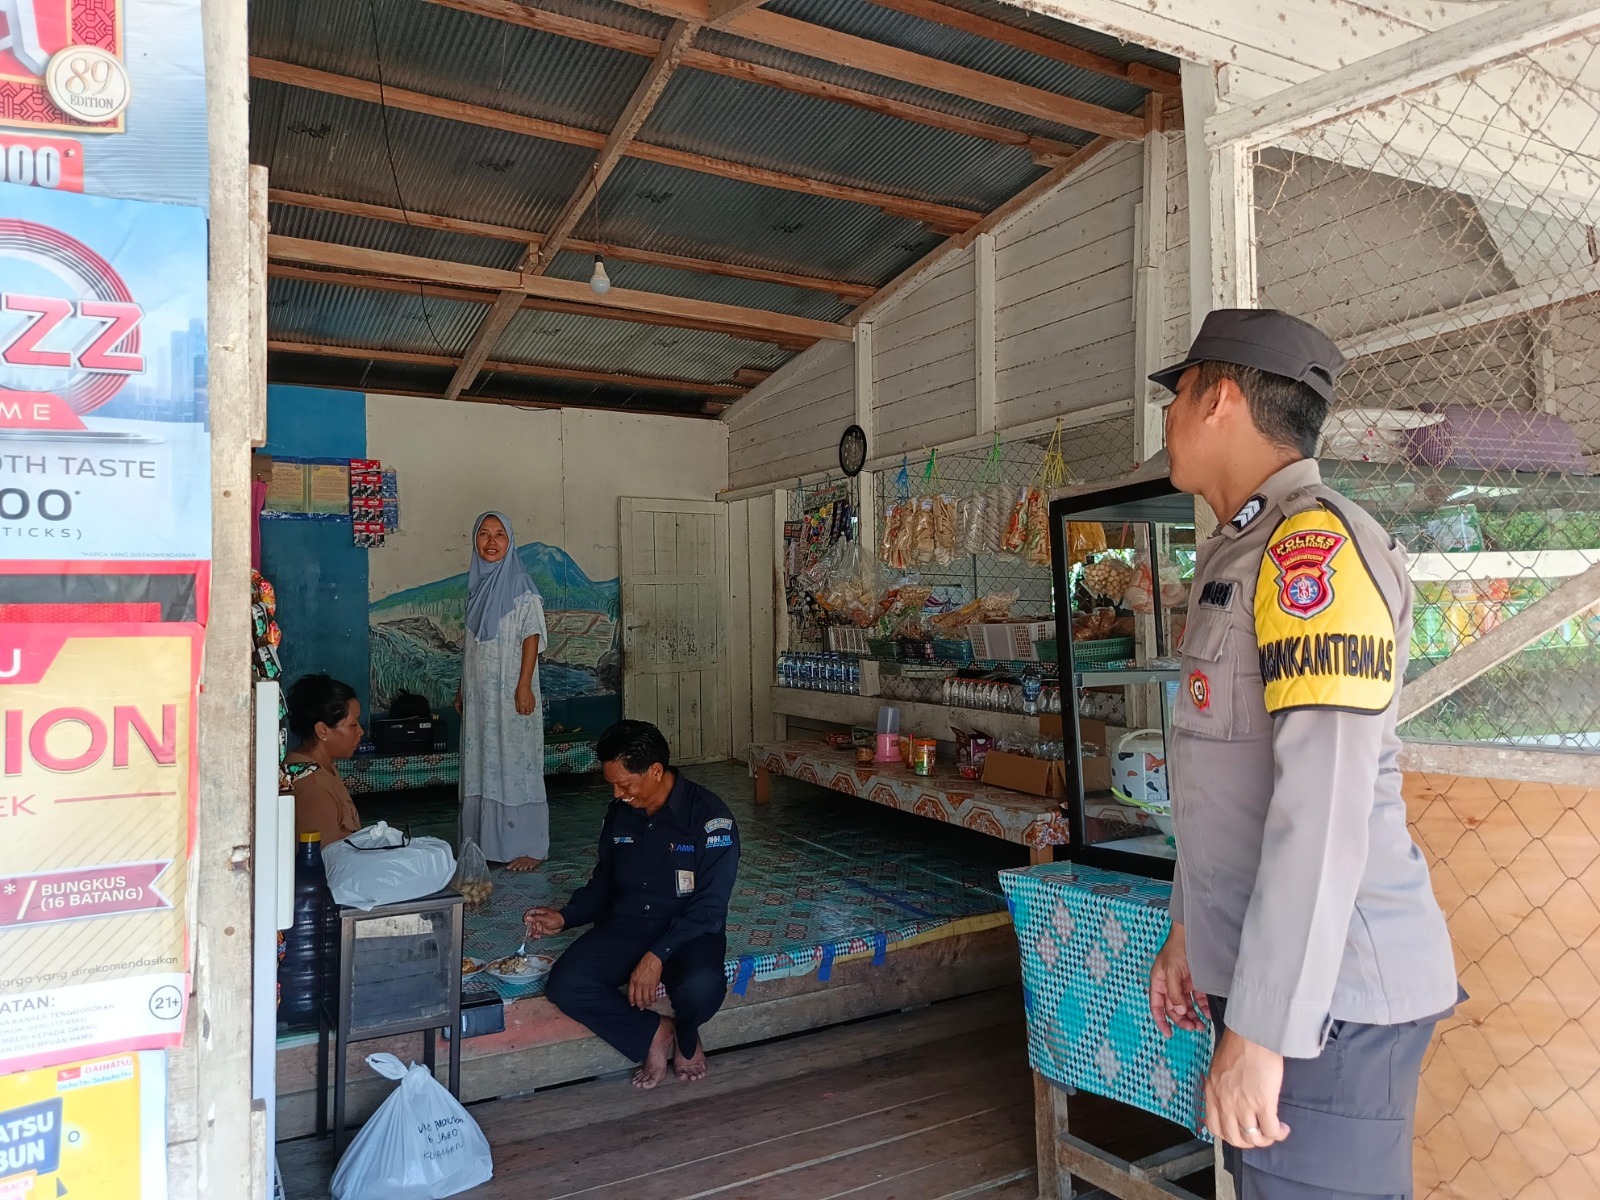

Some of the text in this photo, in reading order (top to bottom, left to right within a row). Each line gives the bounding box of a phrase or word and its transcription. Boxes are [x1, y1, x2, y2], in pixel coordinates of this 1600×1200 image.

[65, 57, 113, 96] 89
[69, 95, 114, 109] EDITION
[0, 454, 156, 479] TH TASTE
[1276, 534, 1336, 555] POLRES
[1280, 541, 1331, 556] LAMANDAU
[5, 703, 177, 777] ION
[41, 876, 126, 896] BUNGKUS
[41, 886, 144, 912] (16 BATANG)
[0, 956, 178, 988] arga yang direkomendasikan
[154, 997, 179, 1010] 21+
[12, 1014, 48, 1025] KANKER
[85, 1059, 133, 1074] DAIHATSU
